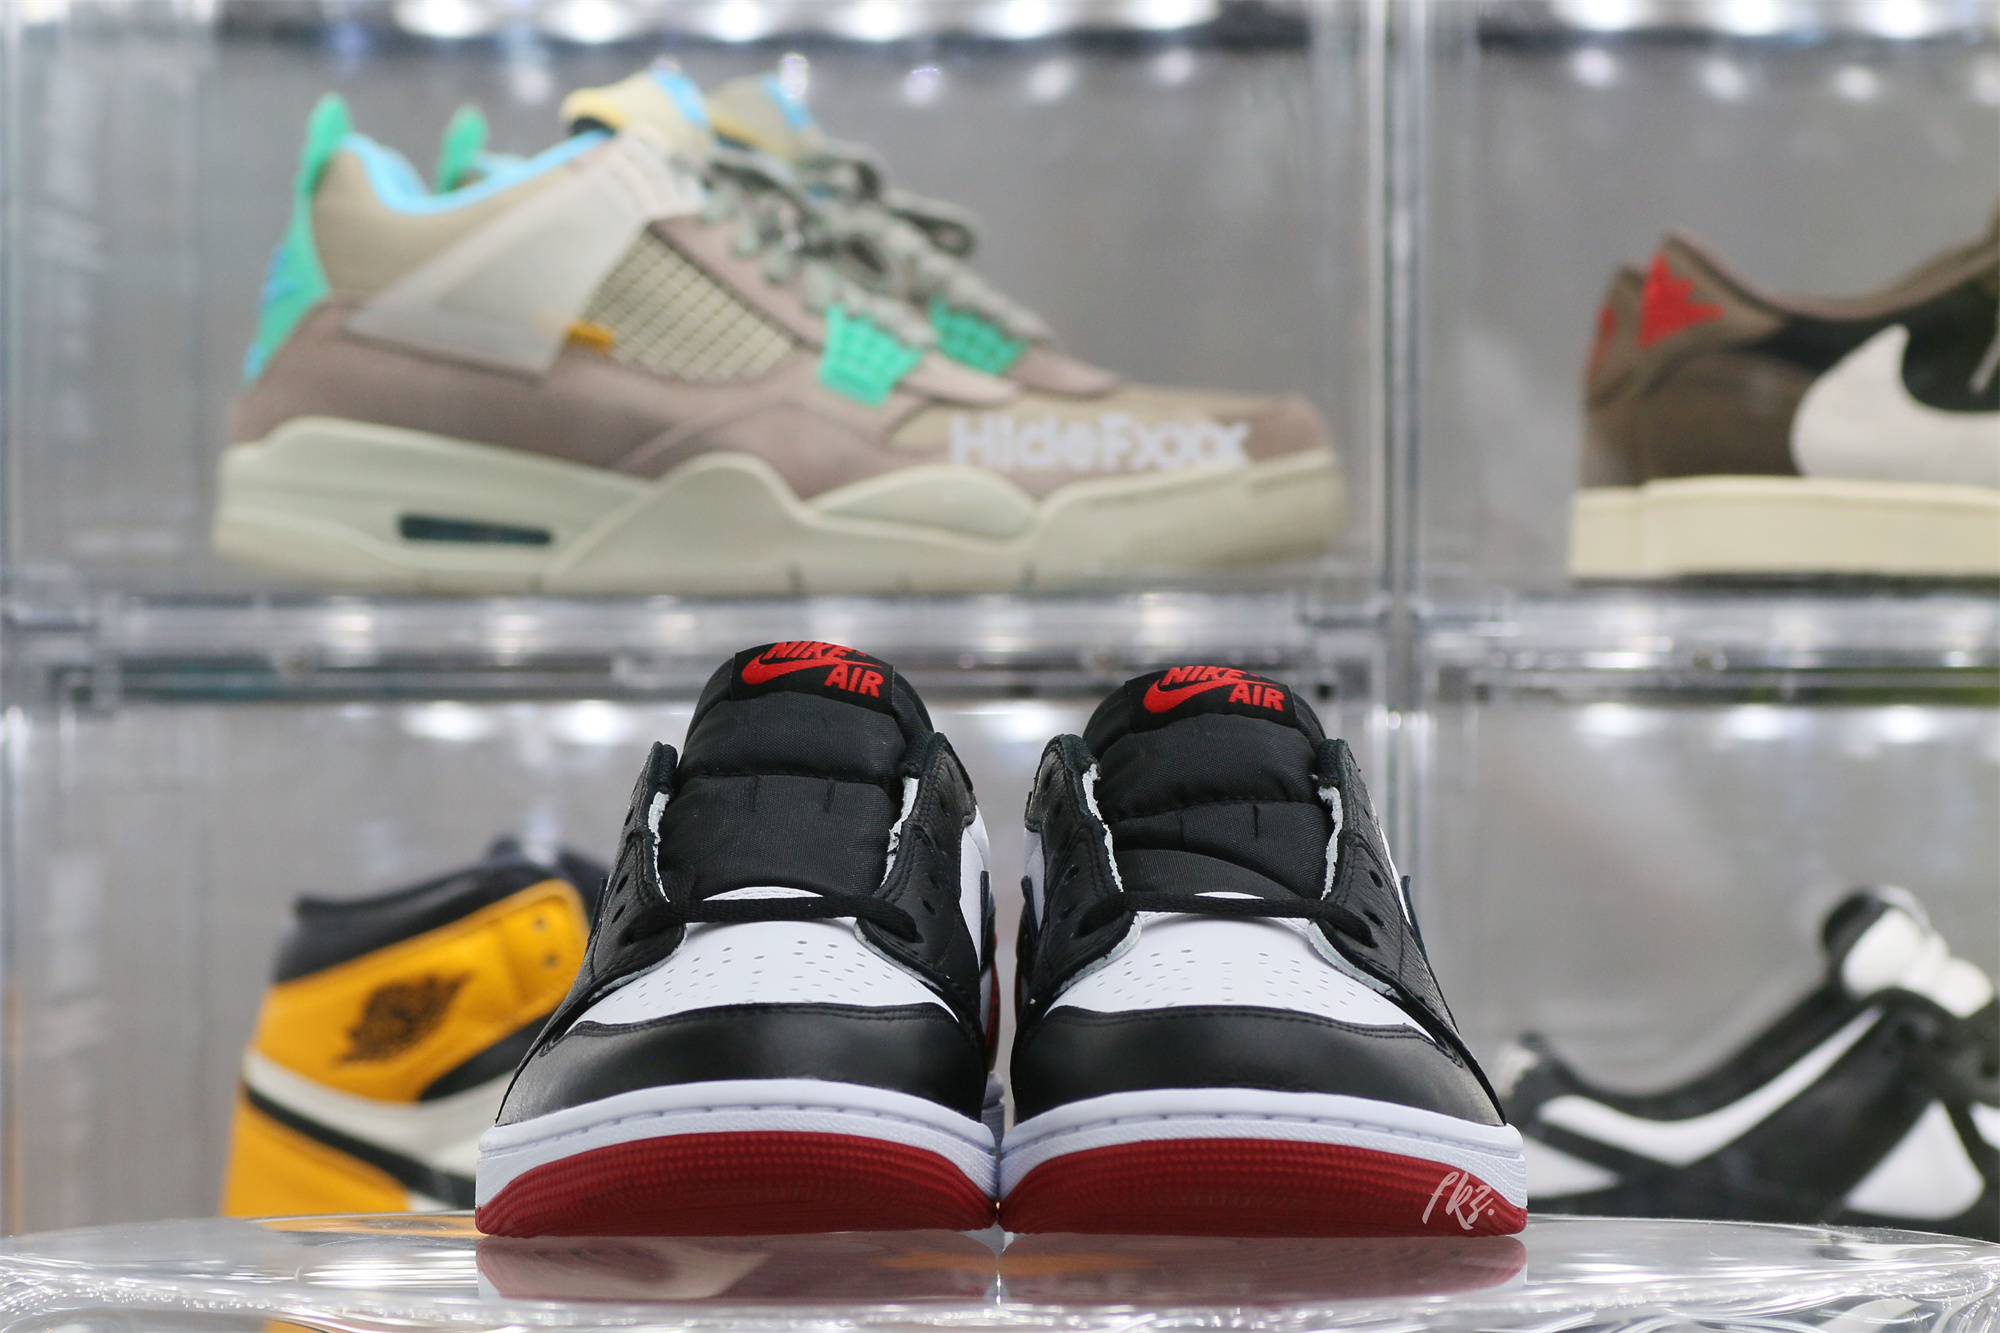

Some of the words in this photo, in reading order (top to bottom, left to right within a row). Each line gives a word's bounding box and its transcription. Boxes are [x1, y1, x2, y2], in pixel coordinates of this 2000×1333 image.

[762, 641, 854, 660] NIKE
[823, 663, 885, 698] AIR
[1161, 665, 1248, 686] NIKE
[1228, 683, 1285, 712] AIR
